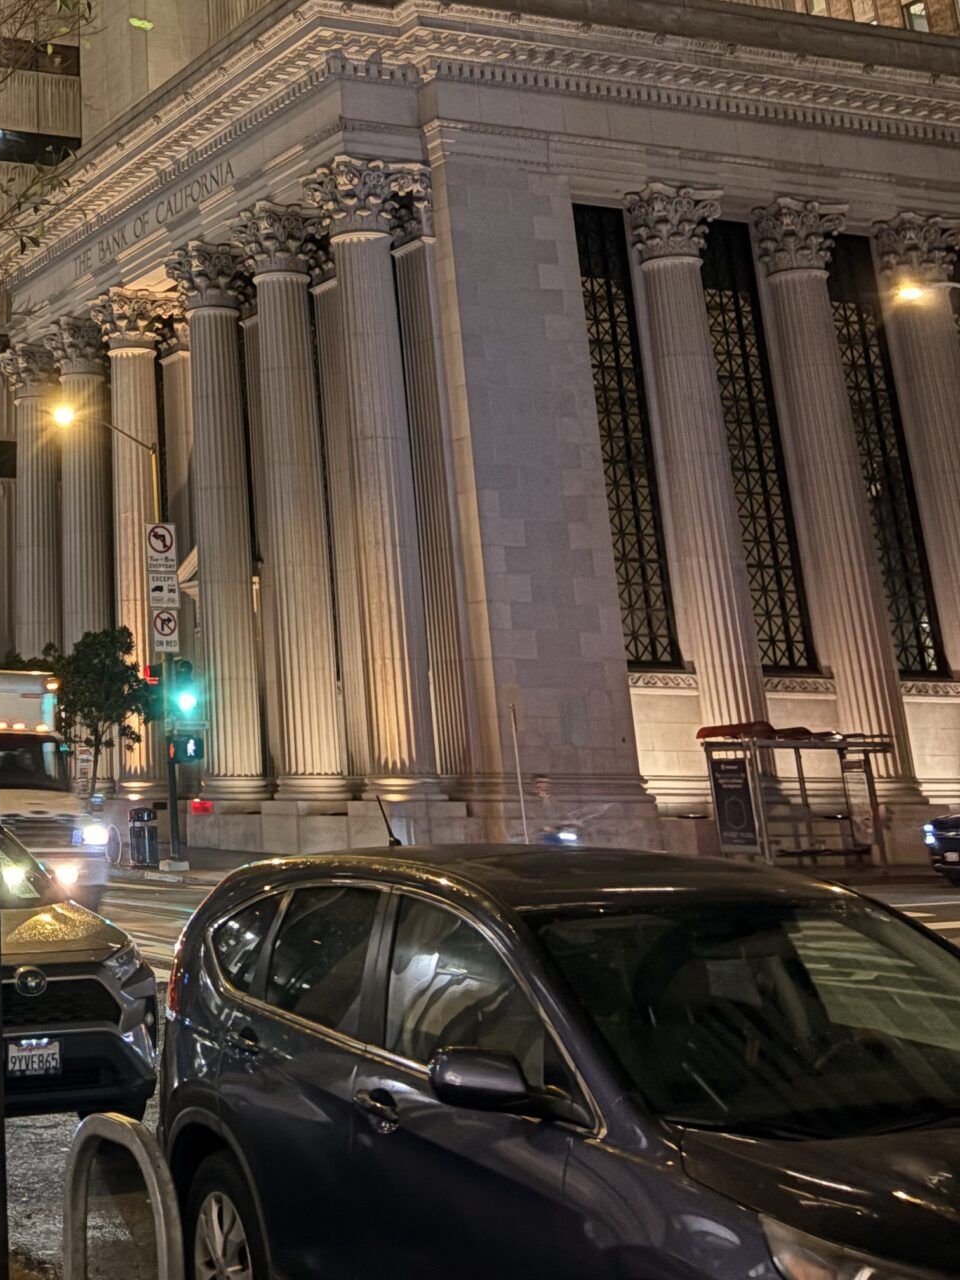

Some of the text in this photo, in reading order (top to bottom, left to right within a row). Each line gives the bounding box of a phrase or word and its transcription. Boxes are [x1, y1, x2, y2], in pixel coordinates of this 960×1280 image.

[73, 159, 235, 277] THE BANK OF CALIFORNIA
[155, 640, 178, 648] ON RED
